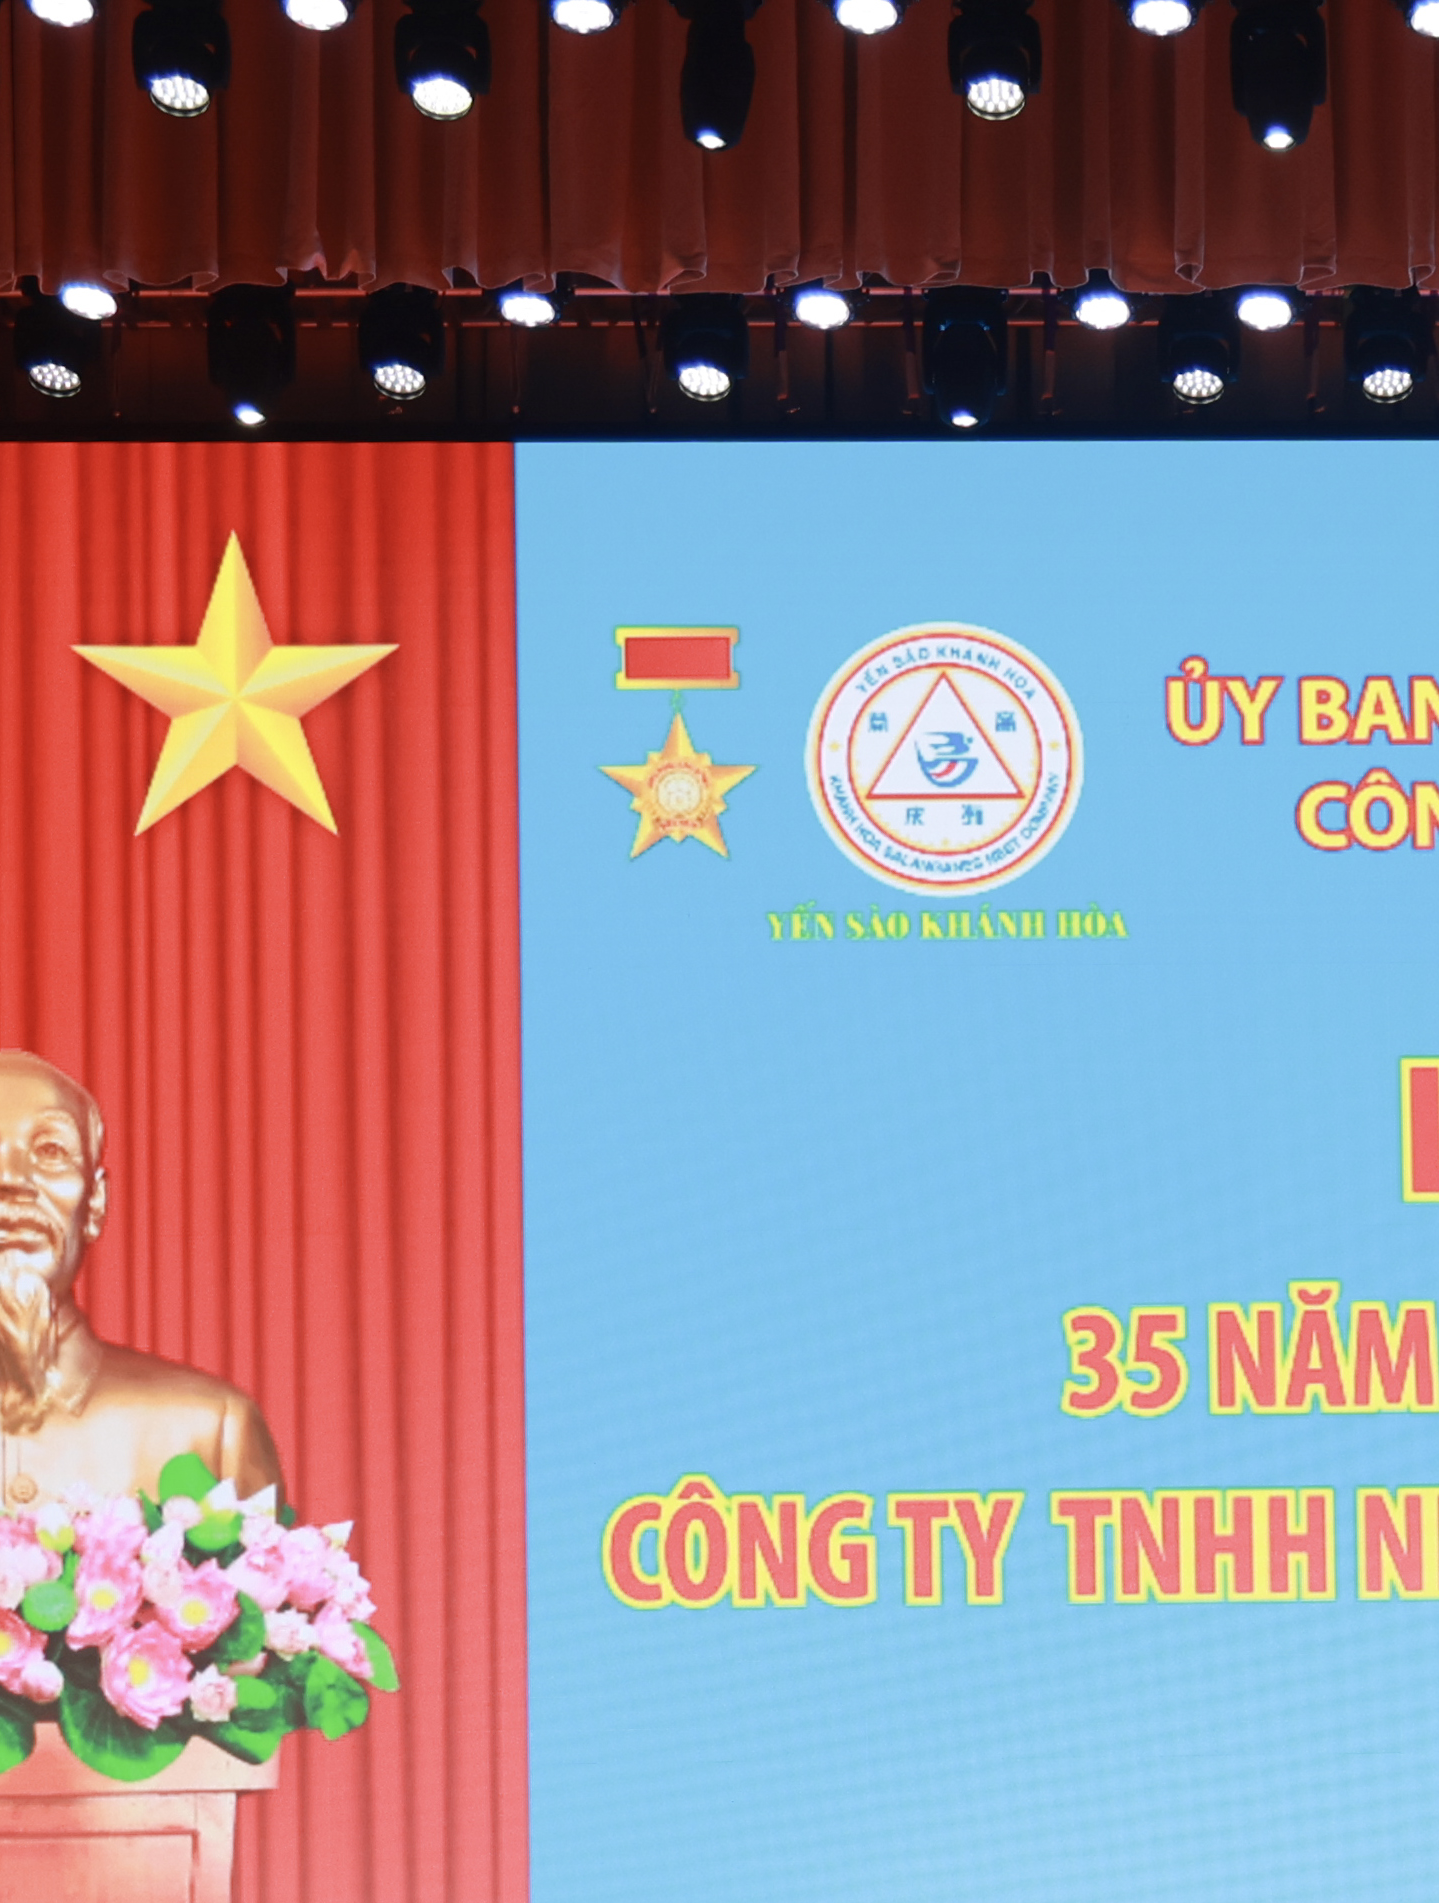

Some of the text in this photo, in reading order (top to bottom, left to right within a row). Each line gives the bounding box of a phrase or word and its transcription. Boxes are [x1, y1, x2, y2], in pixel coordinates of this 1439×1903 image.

[1165, 656, 1283, 745] ỦY
[767, 900, 1130, 941] YẾN SÀO KHÁNH HÒA
[1061, 1306, 1188, 1418] 35
[1208, 1278, 1437, 1415] NĂM
[600, 1474, 882, 1609] CÔNG
[889, 1489, 1026, 1607] TY
[1051, 1486, 1338, 1605] TNHH
